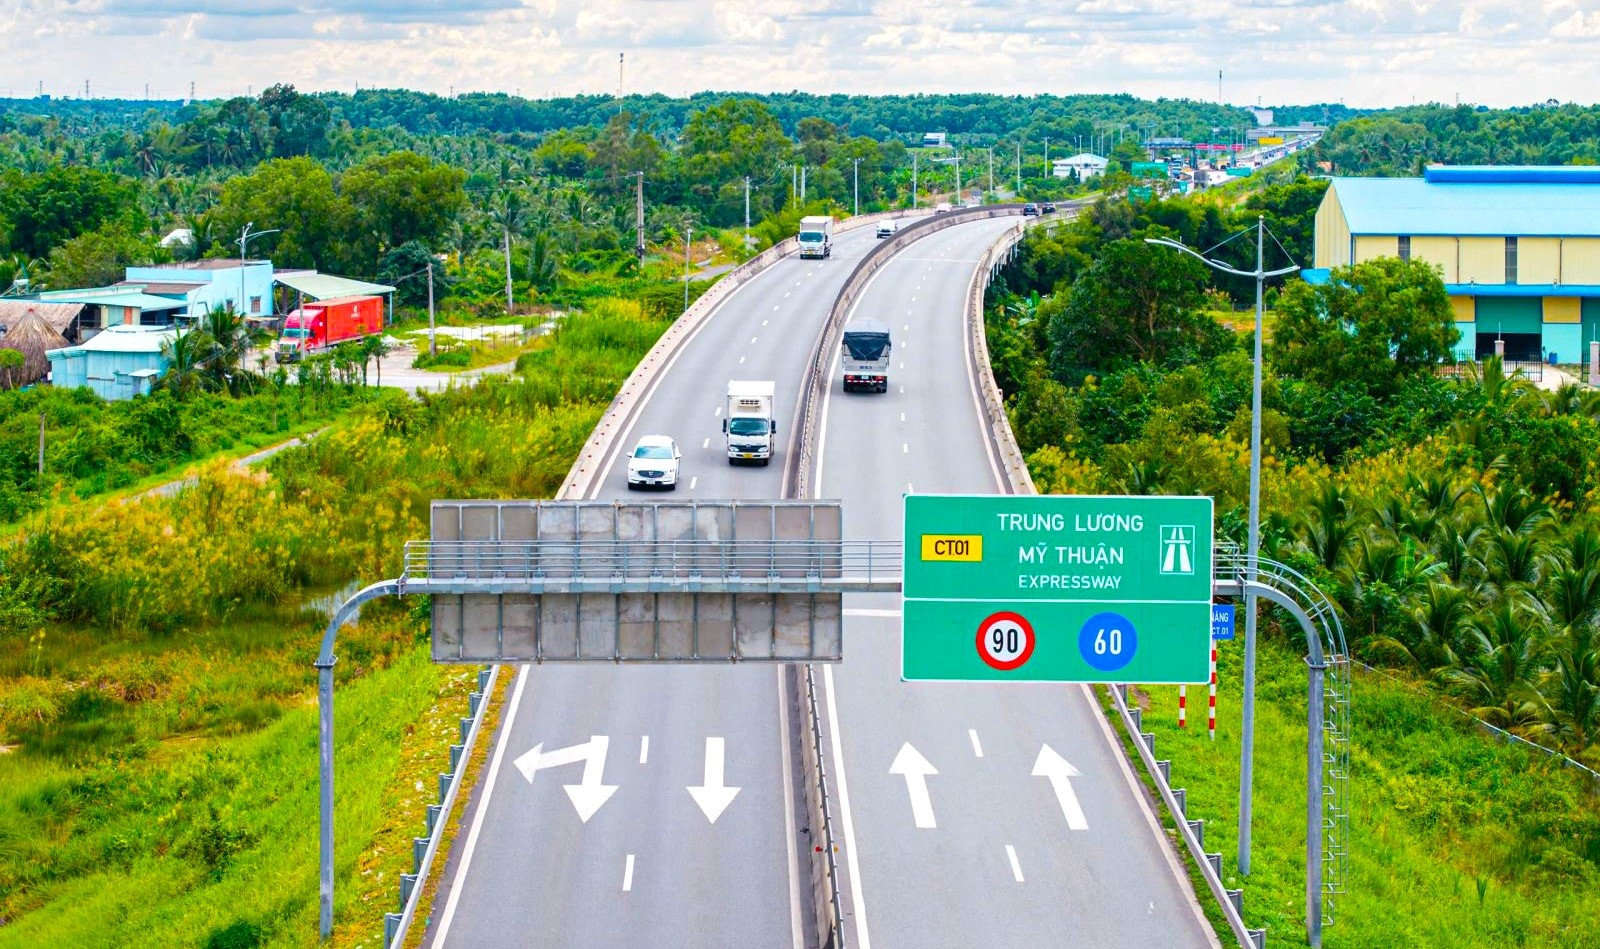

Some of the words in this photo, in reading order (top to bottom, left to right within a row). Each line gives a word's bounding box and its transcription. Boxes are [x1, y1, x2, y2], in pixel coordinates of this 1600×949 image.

[997, 513, 1064, 531] TRUNG
[1075, 512, 1144, 532] LƯƠNG
[1018, 541, 1048, 564] MỸ
[1055, 542, 1124, 570] THUẬN
[1018, 574, 1122, 589] EXPRESSWAY
[992, 628, 1019, 653] 90
[1094, 629, 1122, 655] 60
